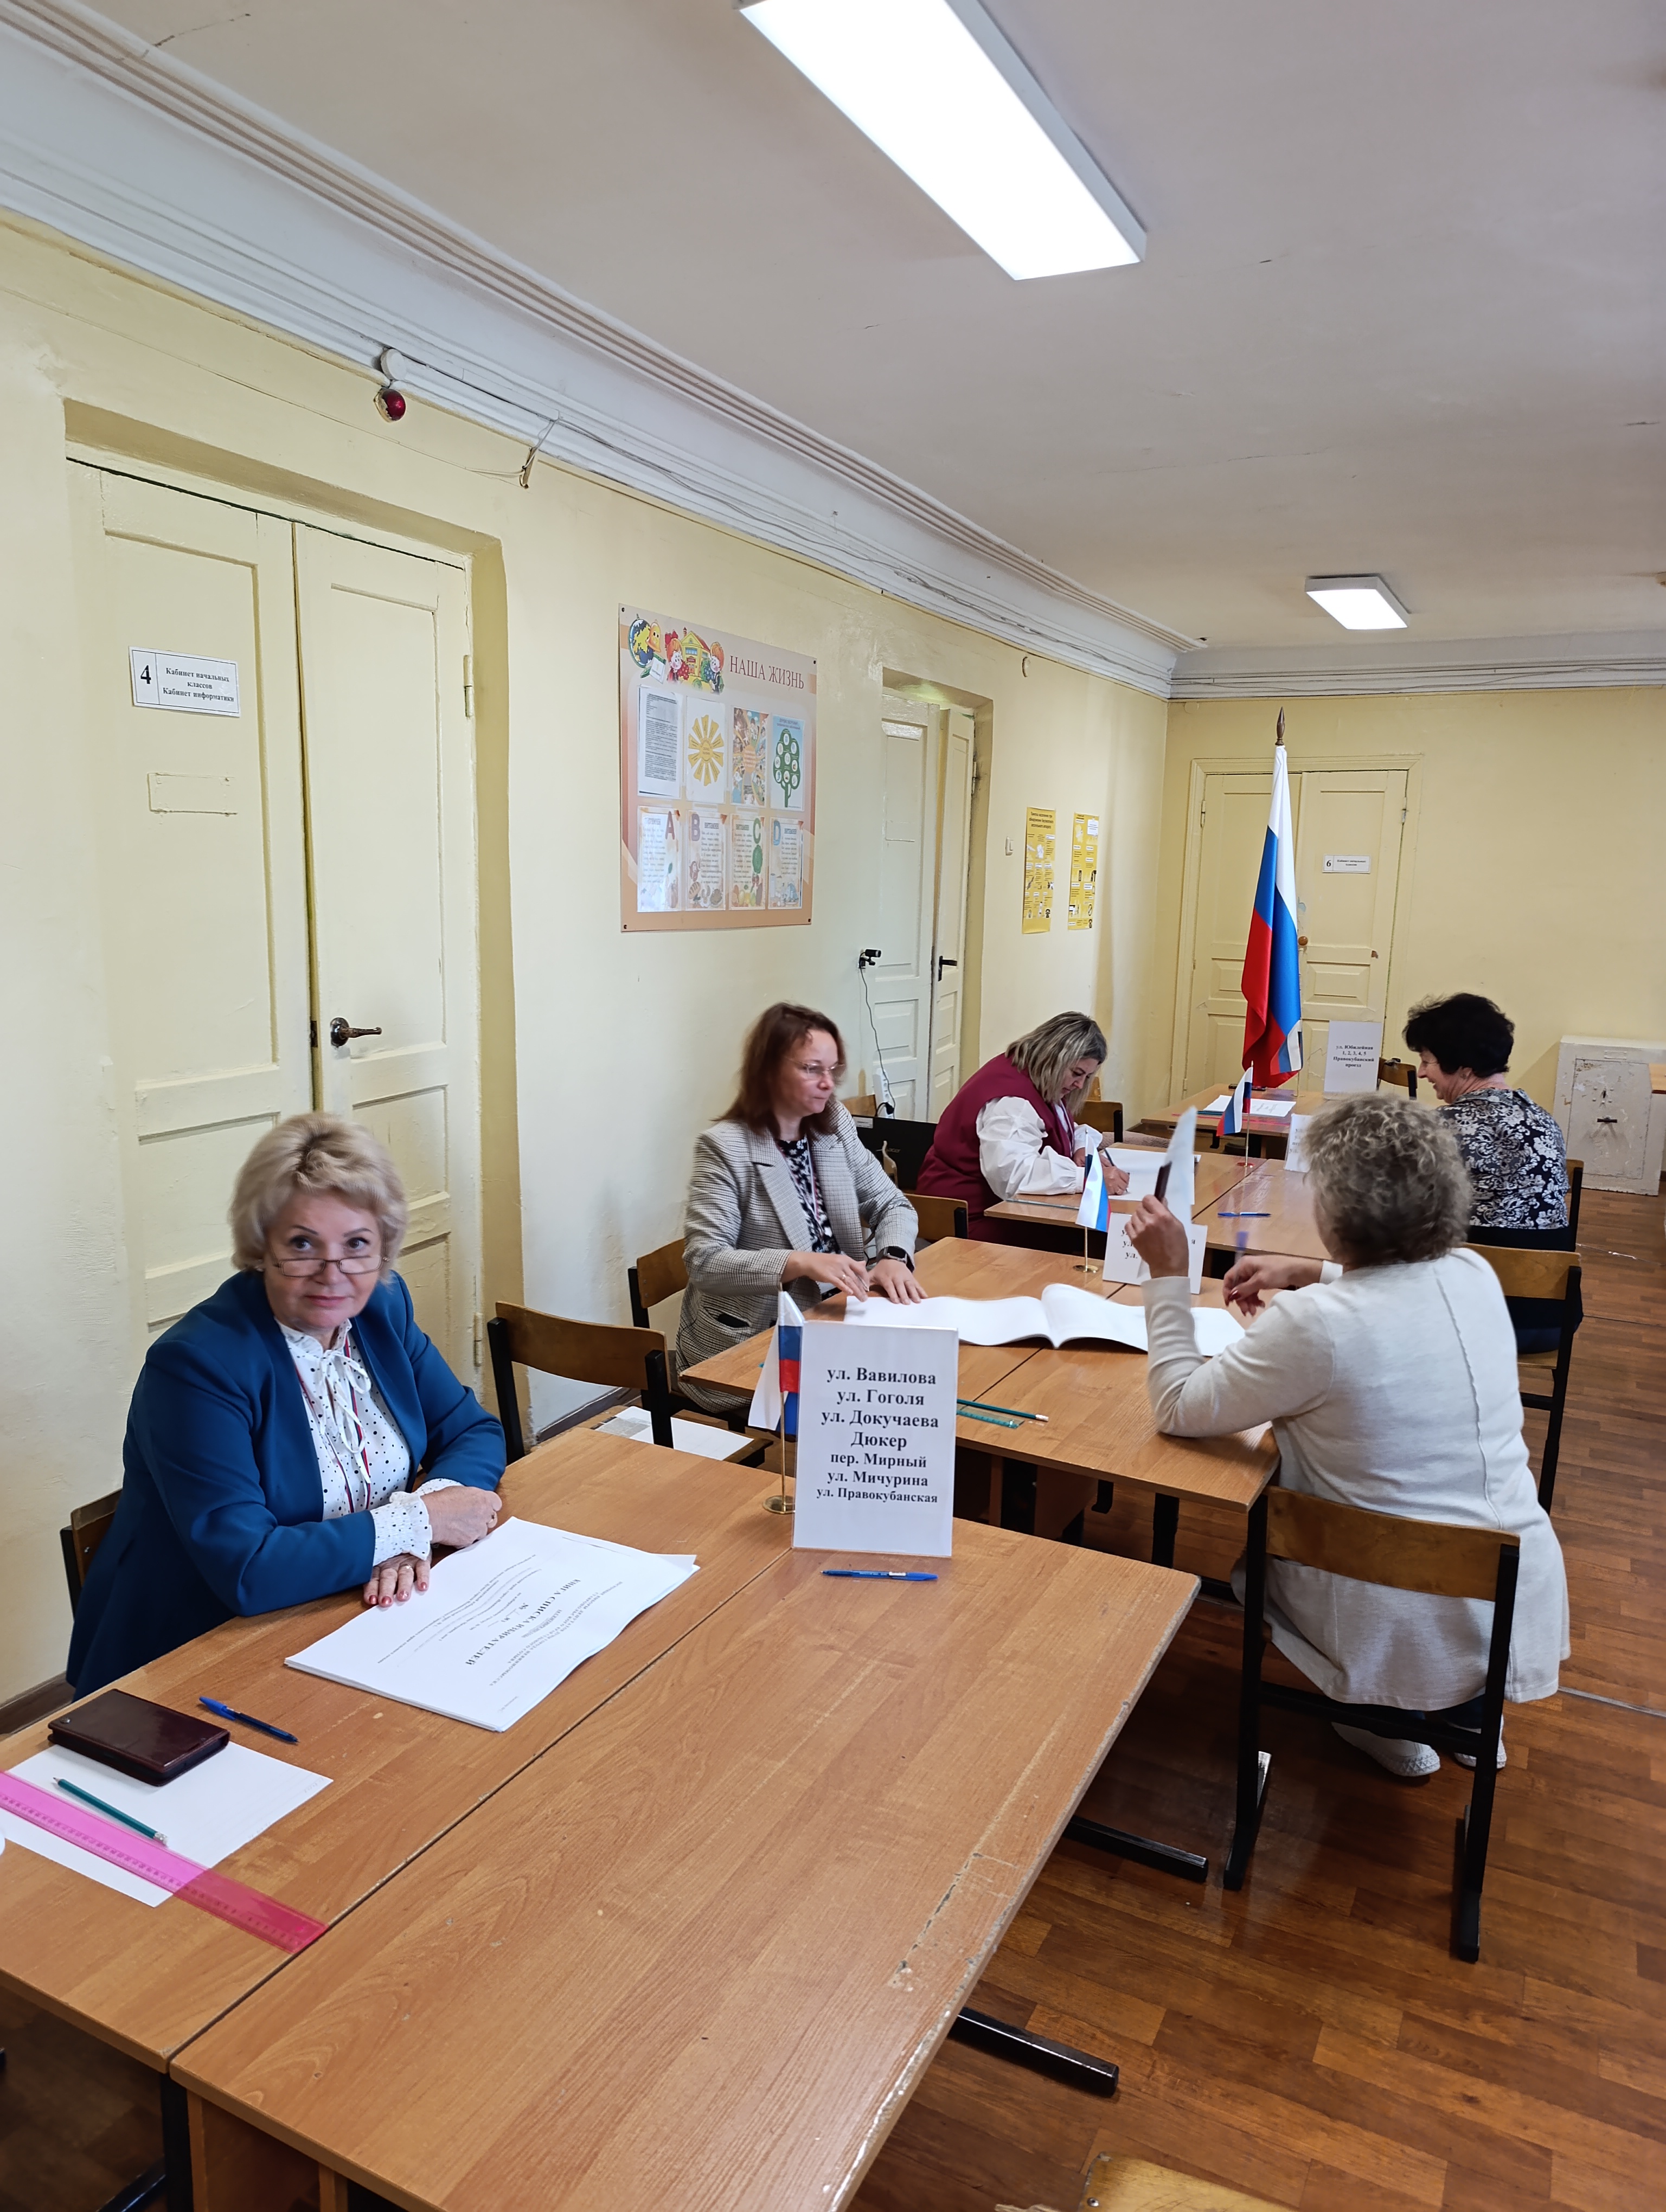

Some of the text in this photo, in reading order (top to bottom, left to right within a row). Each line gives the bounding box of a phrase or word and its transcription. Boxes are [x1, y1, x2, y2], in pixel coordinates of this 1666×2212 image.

[140, 665, 230, 685] 4 Кабинет начальных
[729, 655, 805, 690] НАША ЖИЗНЬ
[187, 681, 213, 690] классов
[163, 687, 234, 703] Кабинет информатики
[773, 820, 781, 846] D
[827, 1367, 936, 1385] ул. Вавилова
[837, 1389, 925, 1406] ул. Гоголя
[821, 1410, 939, 1429] ул. Докучаева
[850, 1431, 907, 1451] Дюкер
[831, 1452, 927, 1469] пер. Мирный
[827, 1470, 928, 1488] ул. Мичурина
[817, 1487, 938, 1503] ул. Правокубанская
[554, 1579, 581, 1595] КНИГА
[522, 1597, 555, 1623] СПИСКА
[465, 1623, 524, 1666] ИЗБИРАТЕЛЕЙ
